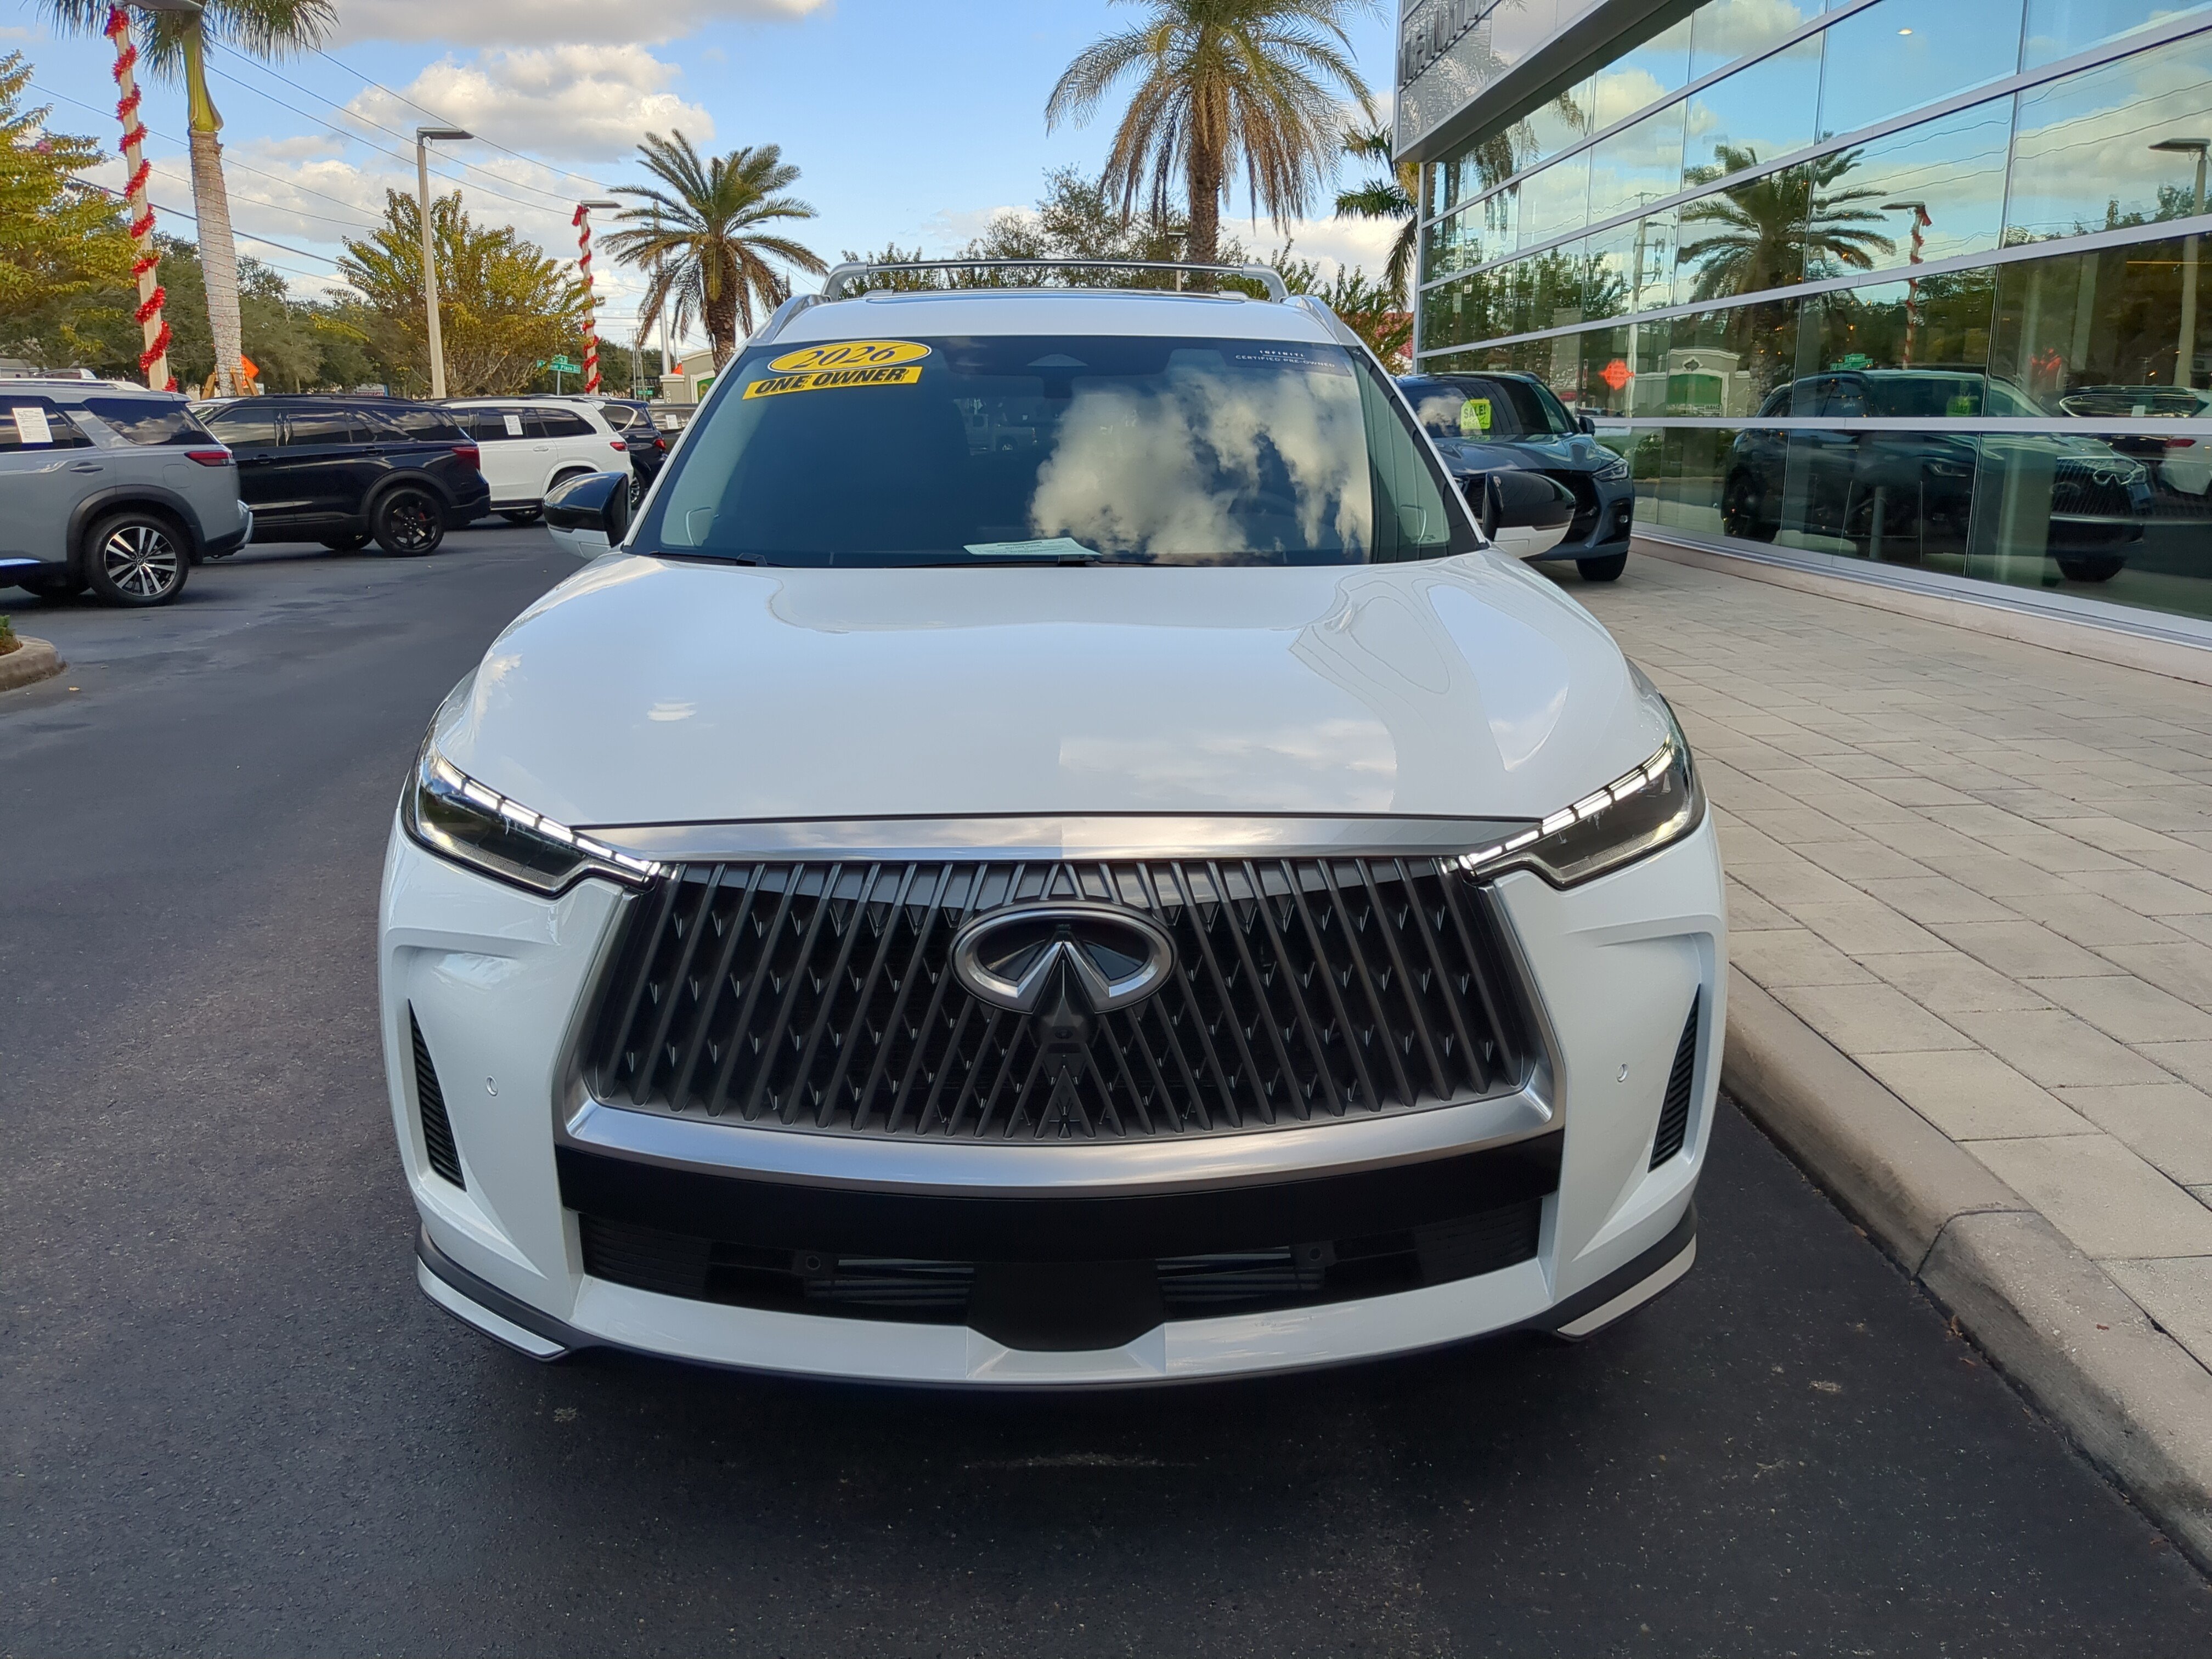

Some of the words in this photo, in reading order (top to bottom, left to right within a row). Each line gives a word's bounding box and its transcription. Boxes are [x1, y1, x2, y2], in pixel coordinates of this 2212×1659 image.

[788, 345, 907, 370] 2026
[1283, 358, 1335, 368] PRE-OWNED
[755, 375, 812, 394] ONE
[812, 368, 909, 386] OWNER
[1464, 404, 1486, 419] SALE!
